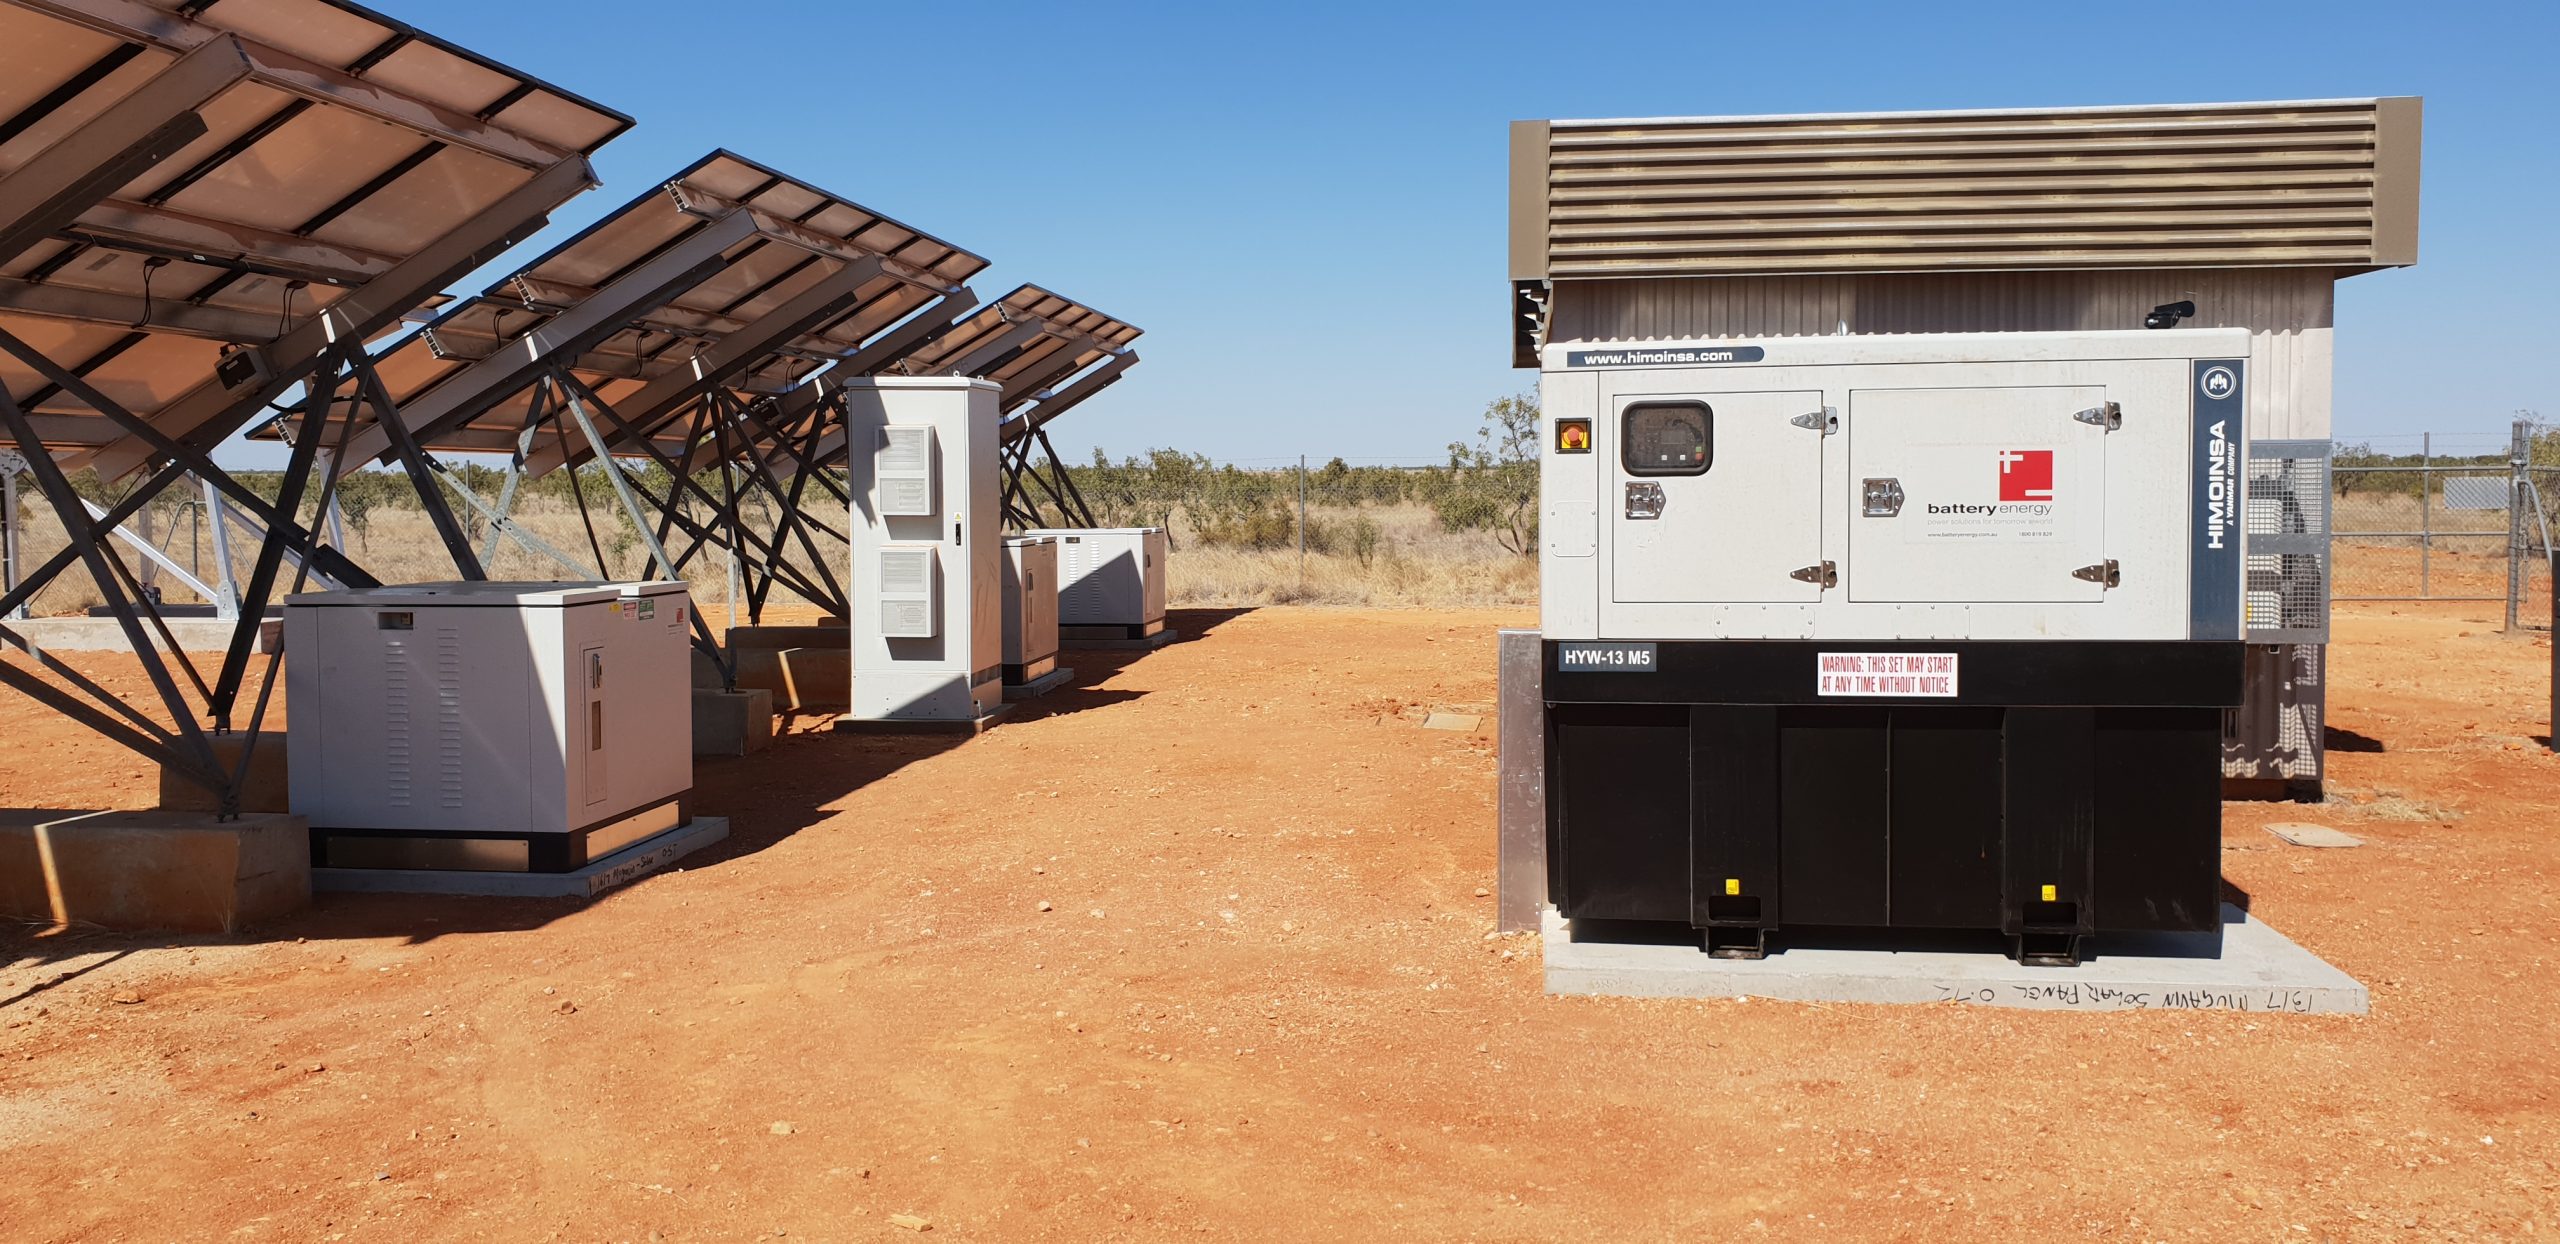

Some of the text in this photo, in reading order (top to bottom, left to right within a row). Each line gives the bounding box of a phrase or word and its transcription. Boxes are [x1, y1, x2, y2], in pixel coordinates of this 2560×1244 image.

[1584, 350, 1733, 365] www.himoinsa.com
[2227, 442, 2236, 476] COMPANY
[2207, 419, 2226, 549] HIMOINSA
[2226, 478, 2235, 518] YANMAR
[1927, 503, 2053, 516] battery energy
[1564, 649, 1650, 665] HYW-13 M5
[1821, 656, 1954, 673] WARNING: THIS SET MAY START
[1821, 675, 1949, 694] AT ANY TIME WITHOUT NOTICE
[2012, 984, 2079, 1005] PANEL
